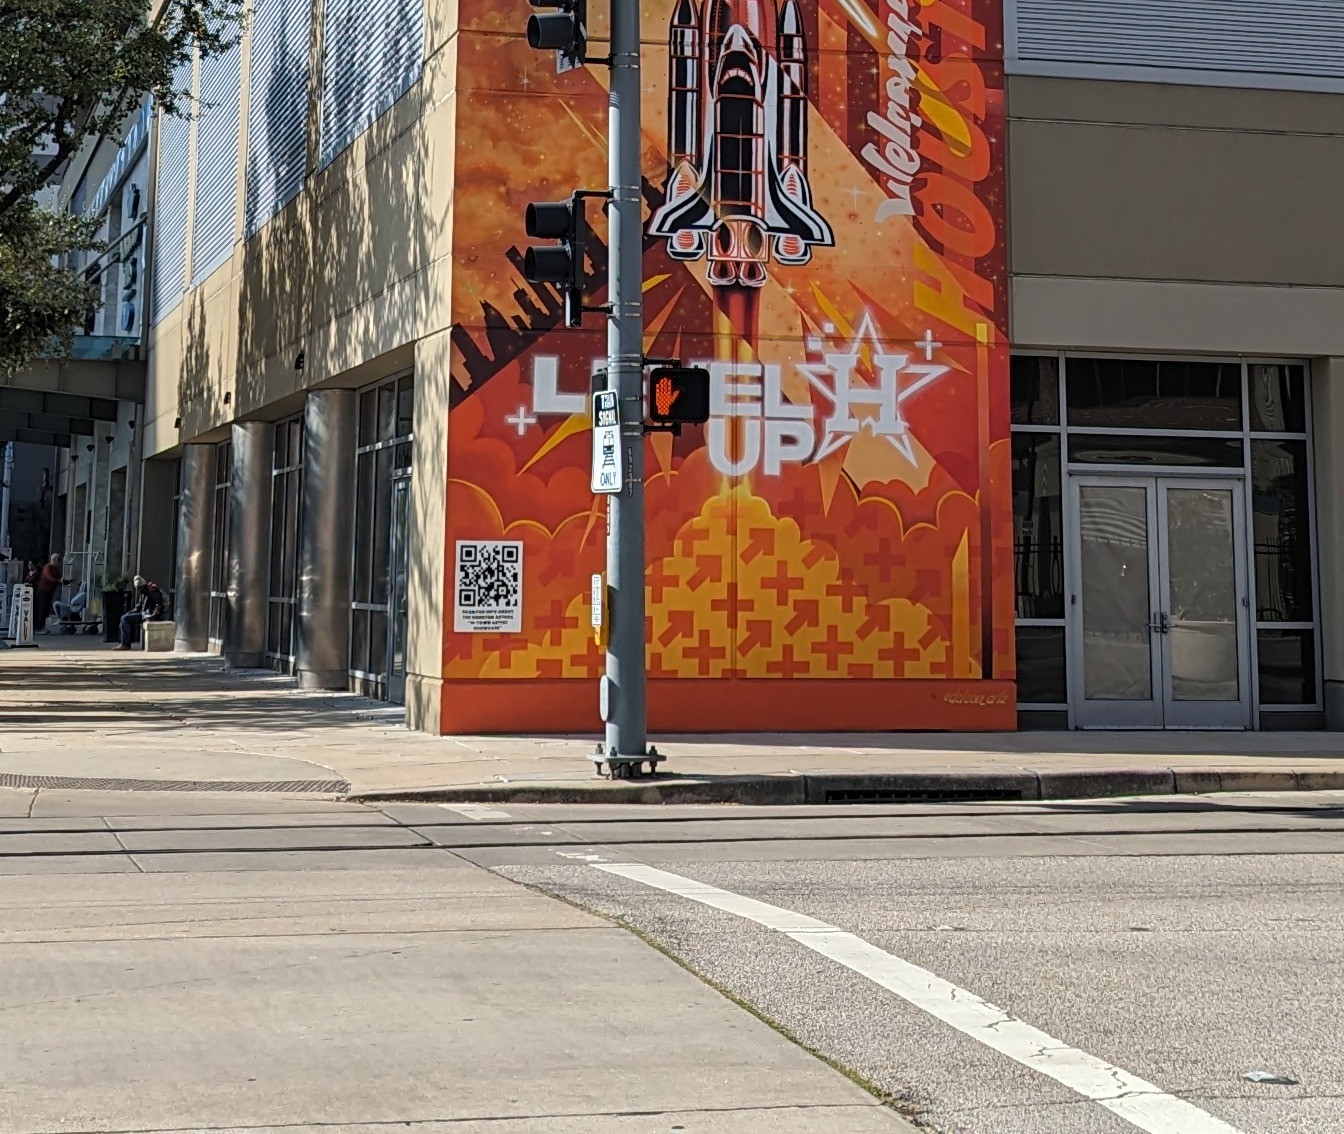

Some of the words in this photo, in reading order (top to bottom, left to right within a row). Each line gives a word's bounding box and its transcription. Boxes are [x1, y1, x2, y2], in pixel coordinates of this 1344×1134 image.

[531, 355, 815, 419] LEL
[708, 418, 816, 477] UP
[600, 471, 617, 487] ONLY
